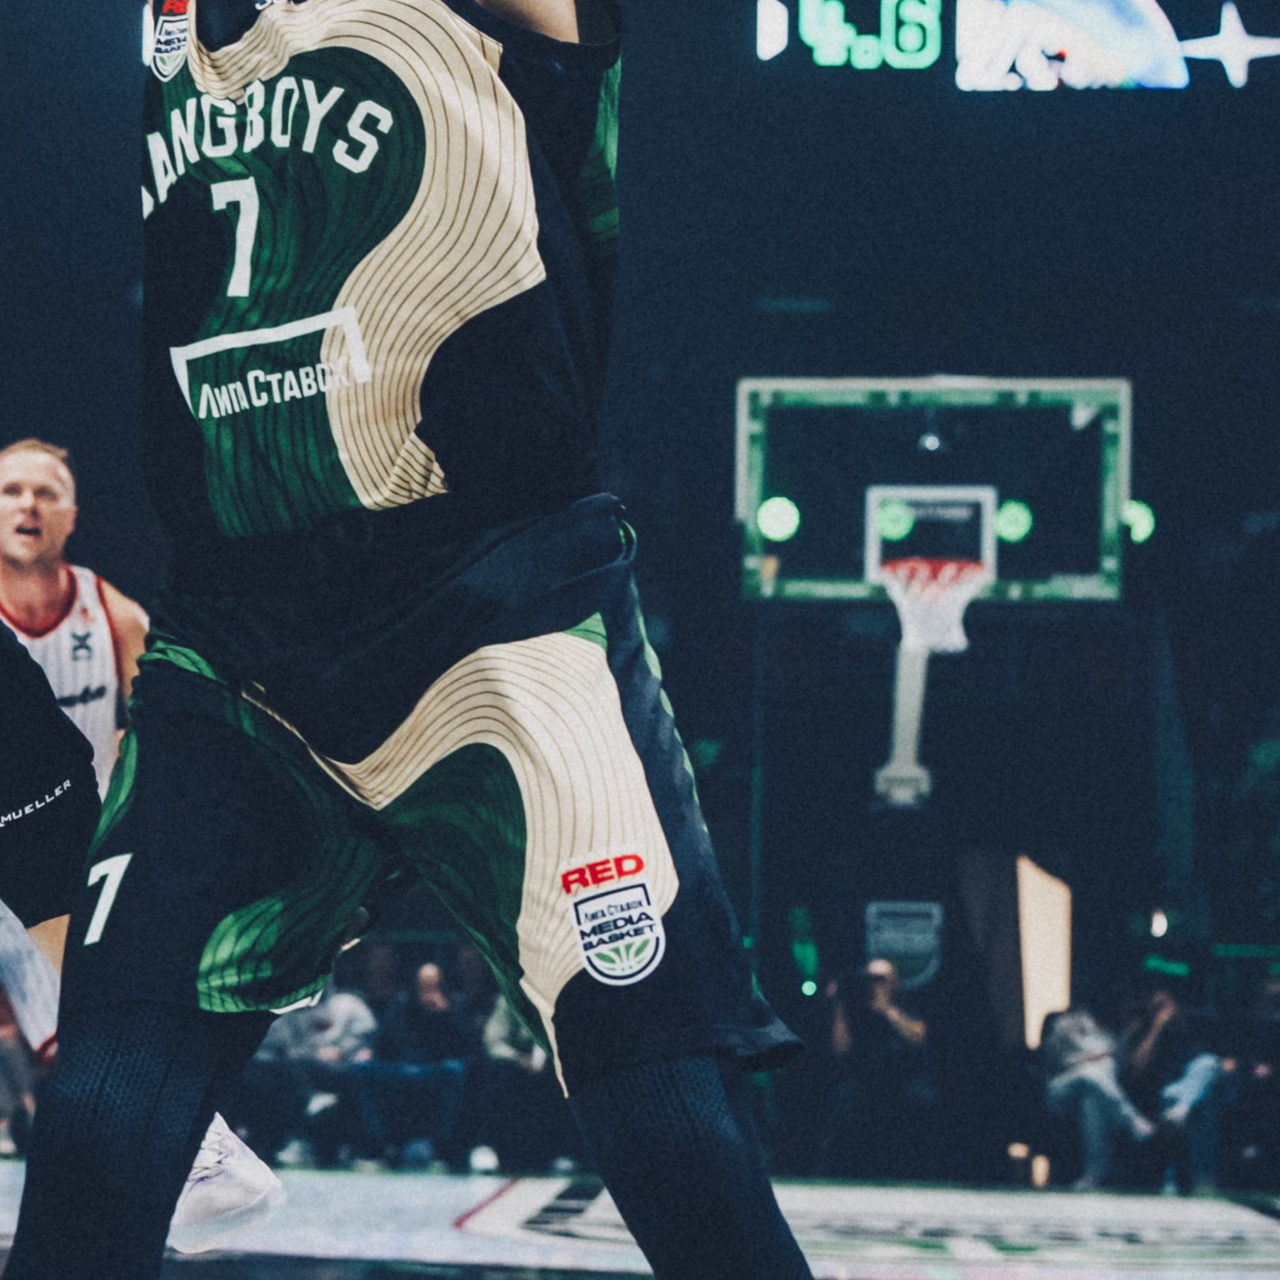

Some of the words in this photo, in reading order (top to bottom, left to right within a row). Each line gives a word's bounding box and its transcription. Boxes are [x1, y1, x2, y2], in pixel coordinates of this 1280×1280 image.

[141, 76, 394, 220] ANGBOYS
[210, 176, 259, 297] 7
[0, 779, 72, 824] MUELLER
[561, 854, 645, 895] RED
[84, 852, 133, 946] 7
[579, 911, 655, 941] MEDIA
[582, 923, 657, 952] BASKET
